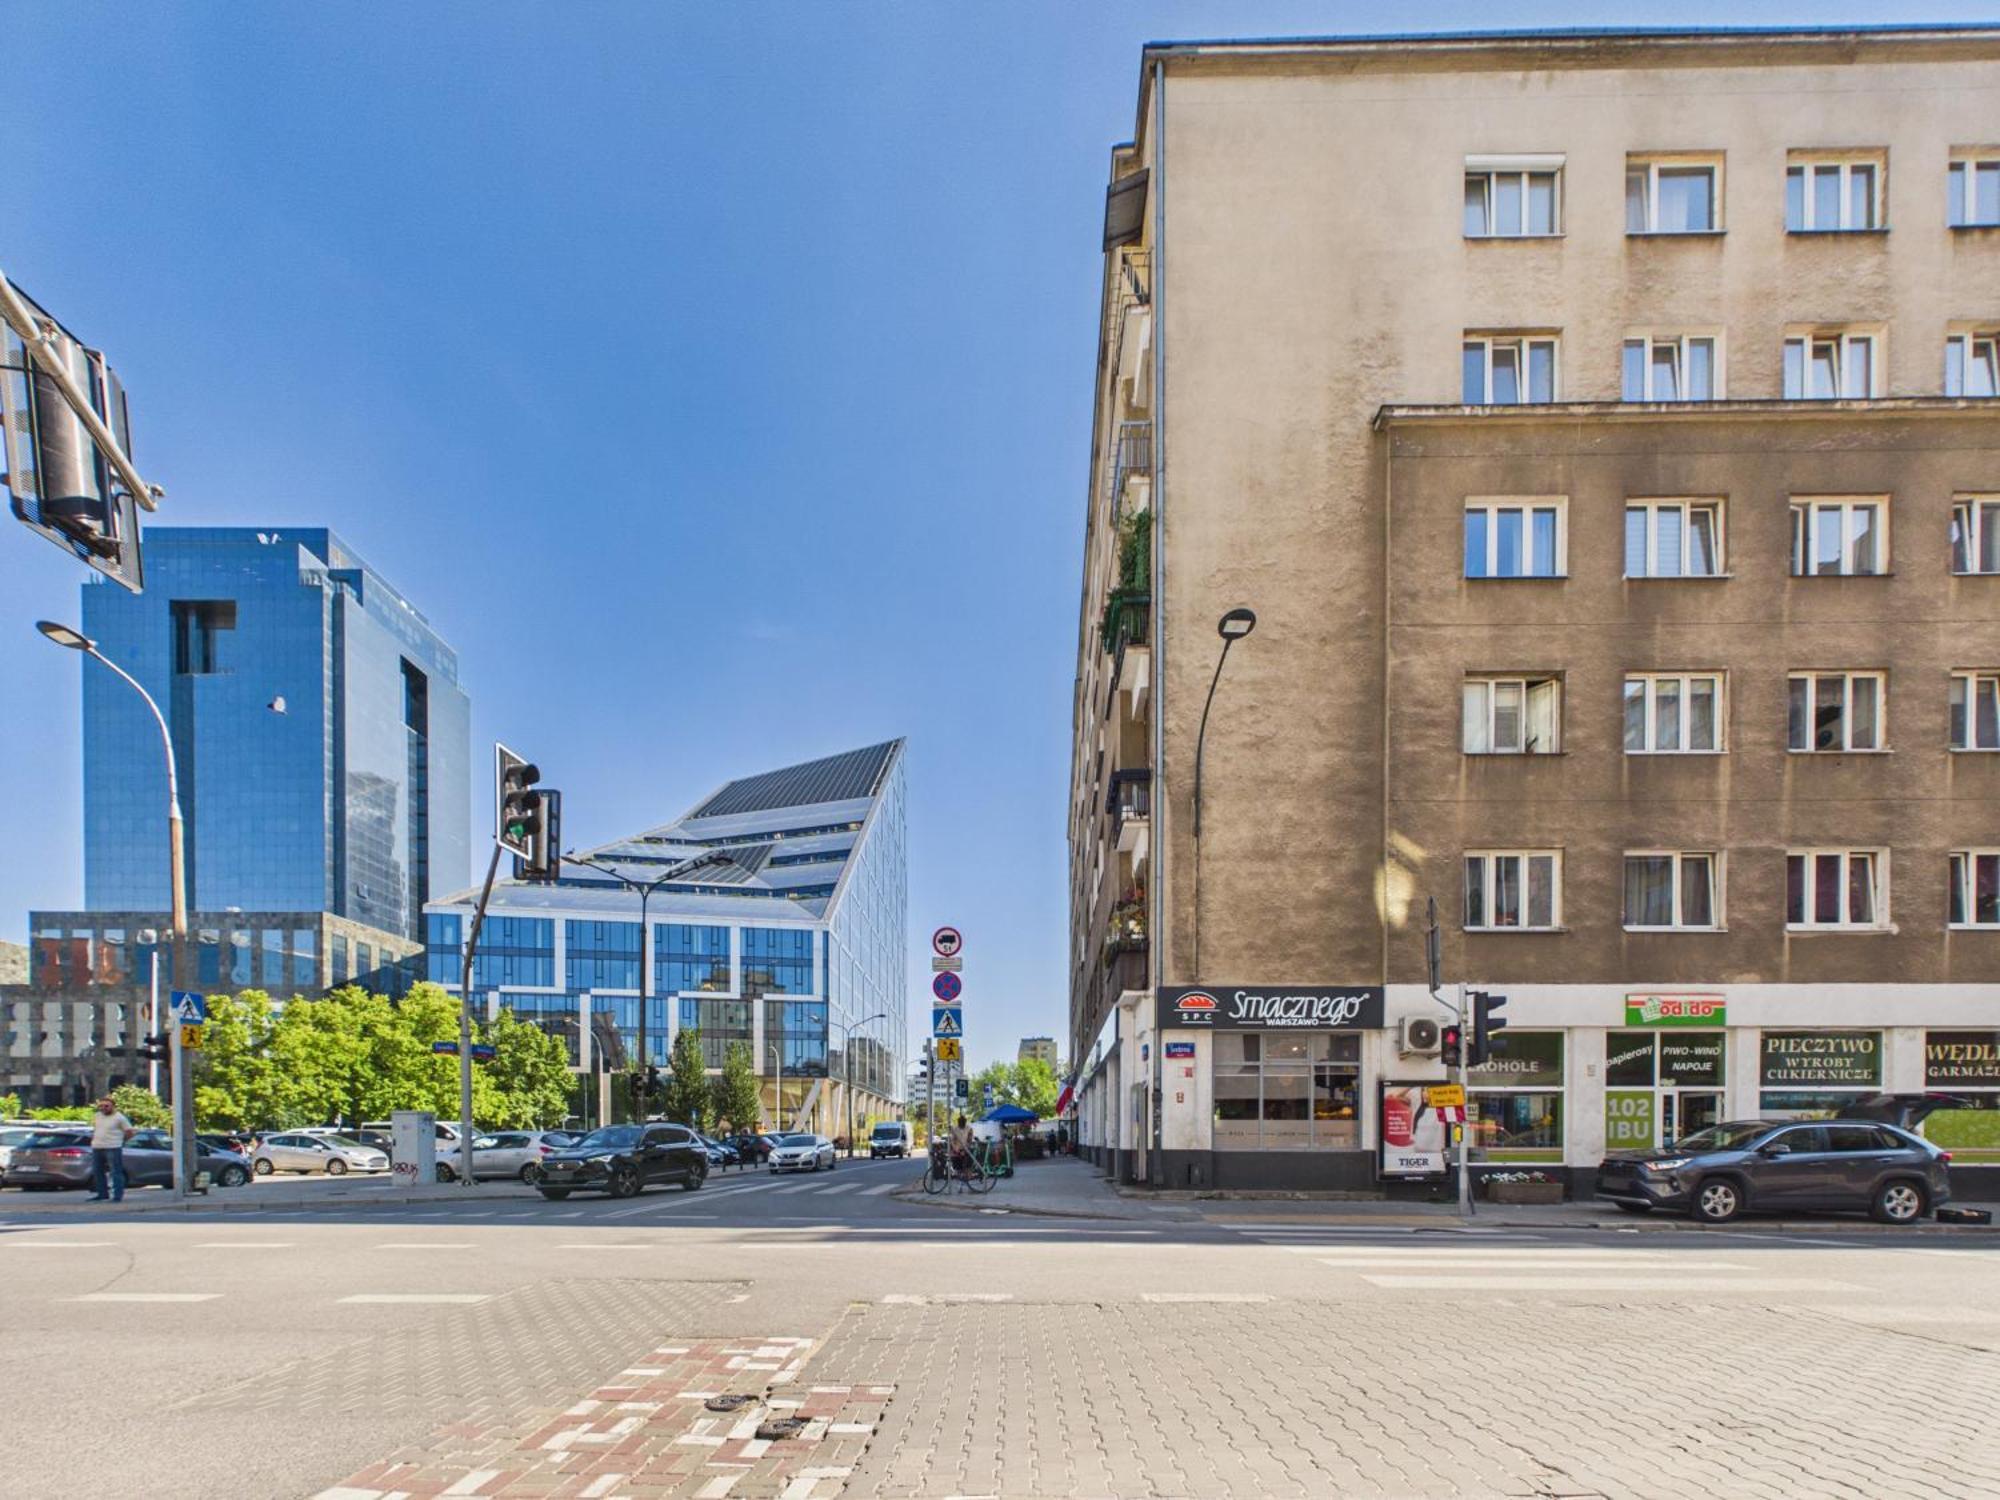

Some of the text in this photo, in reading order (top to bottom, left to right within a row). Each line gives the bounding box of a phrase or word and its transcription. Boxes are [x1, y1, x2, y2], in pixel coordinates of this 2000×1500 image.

[1228, 991, 1370, 1026] Smacznego
[1660, 1001, 1713, 1016] odido
[1266, 1018, 1320, 1026] WARSZAWO
[1767, 1038, 1874, 1054] PIECZYWO
[1605, 1045, 1653, 1069] papierosy
[1785, 1057, 1854, 1068] WYROBY
[1672, 1062, 1713, 1071] NAPOJE
[1767, 1068, 1873, 1080] CUKIERNICZE
[1608, 1098, 1649, 1117] 102
[1608, 1121, 1649, 1140] IBU
[1398, 1158, 1429, 1166] TIGER
